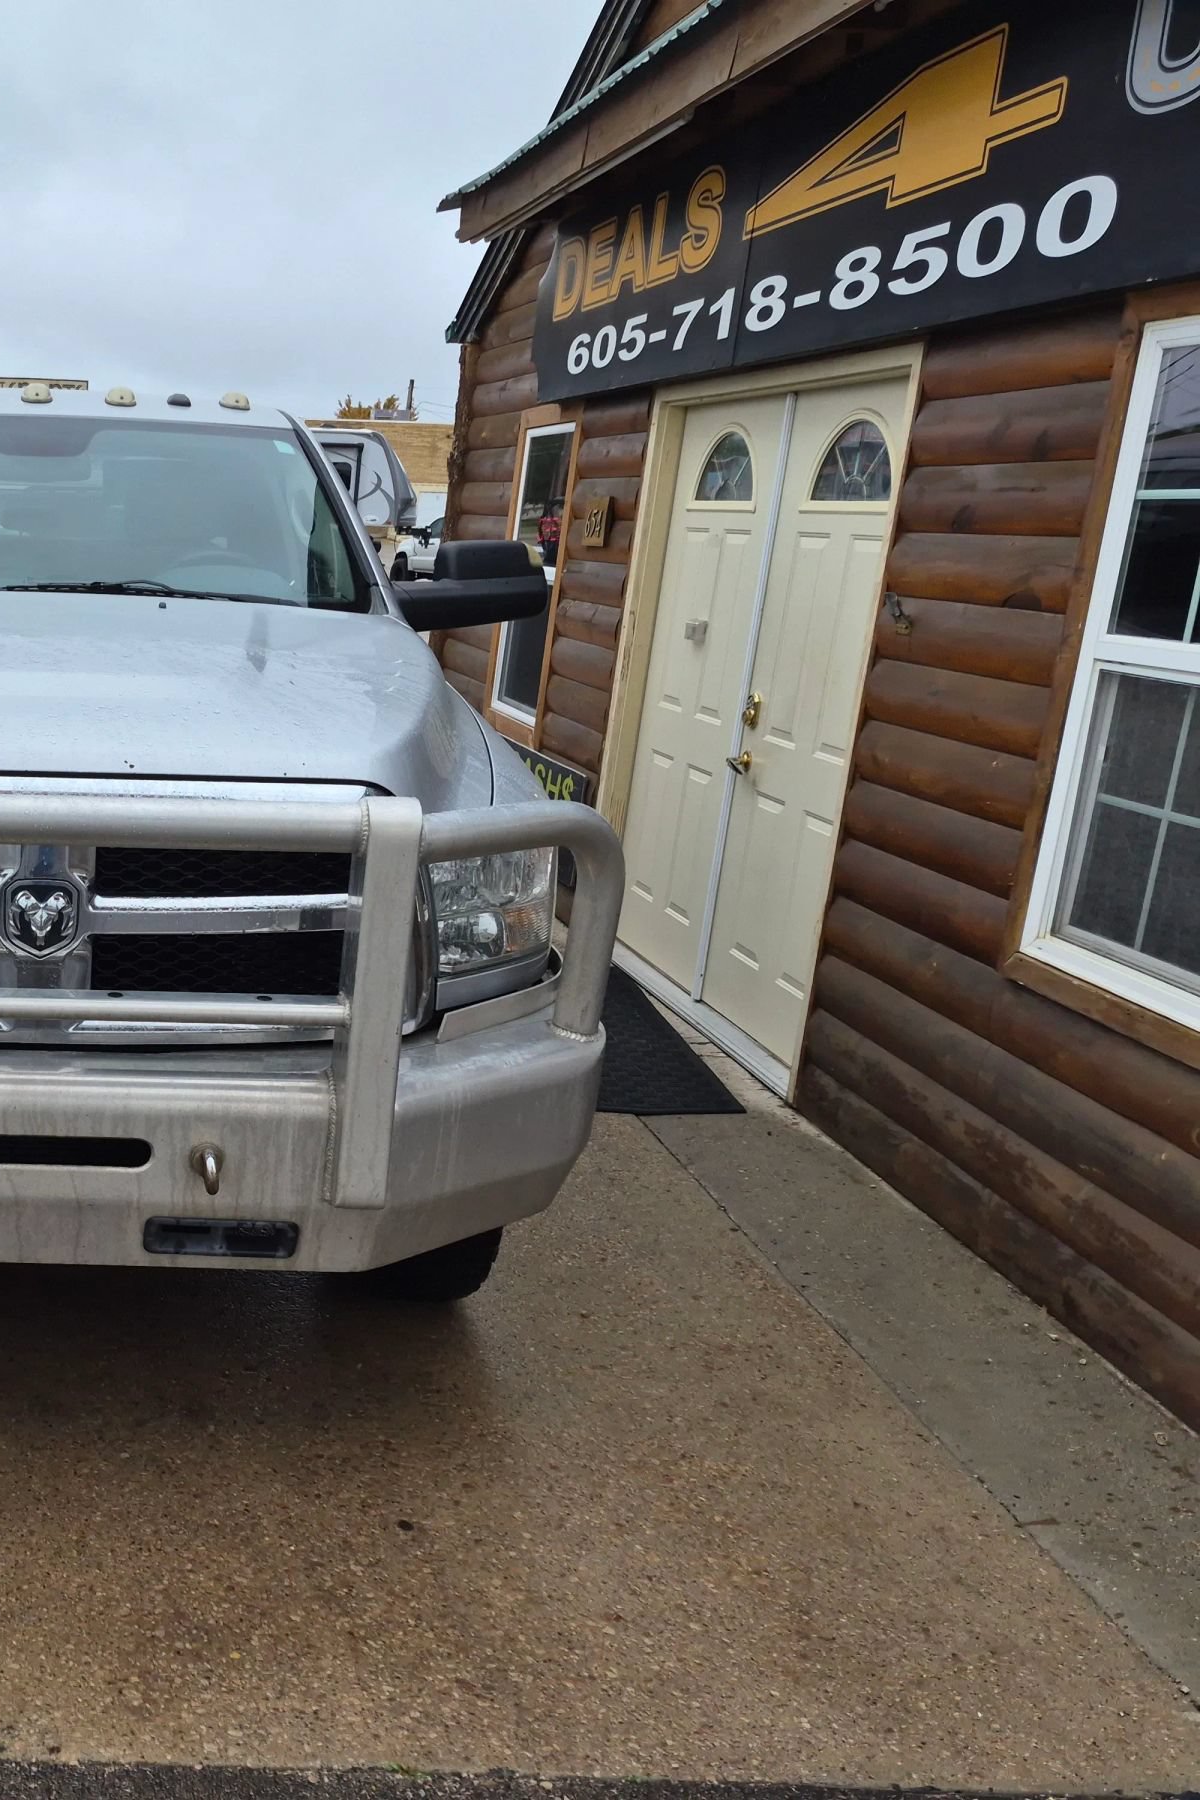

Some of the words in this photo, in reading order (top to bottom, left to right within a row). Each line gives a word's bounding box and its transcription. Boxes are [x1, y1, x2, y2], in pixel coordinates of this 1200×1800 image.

[552, 164, 727, 322] DEALS
[742, 22, 1069, 241] 4
[566, 174, 1118, 375] 605-718-8500
